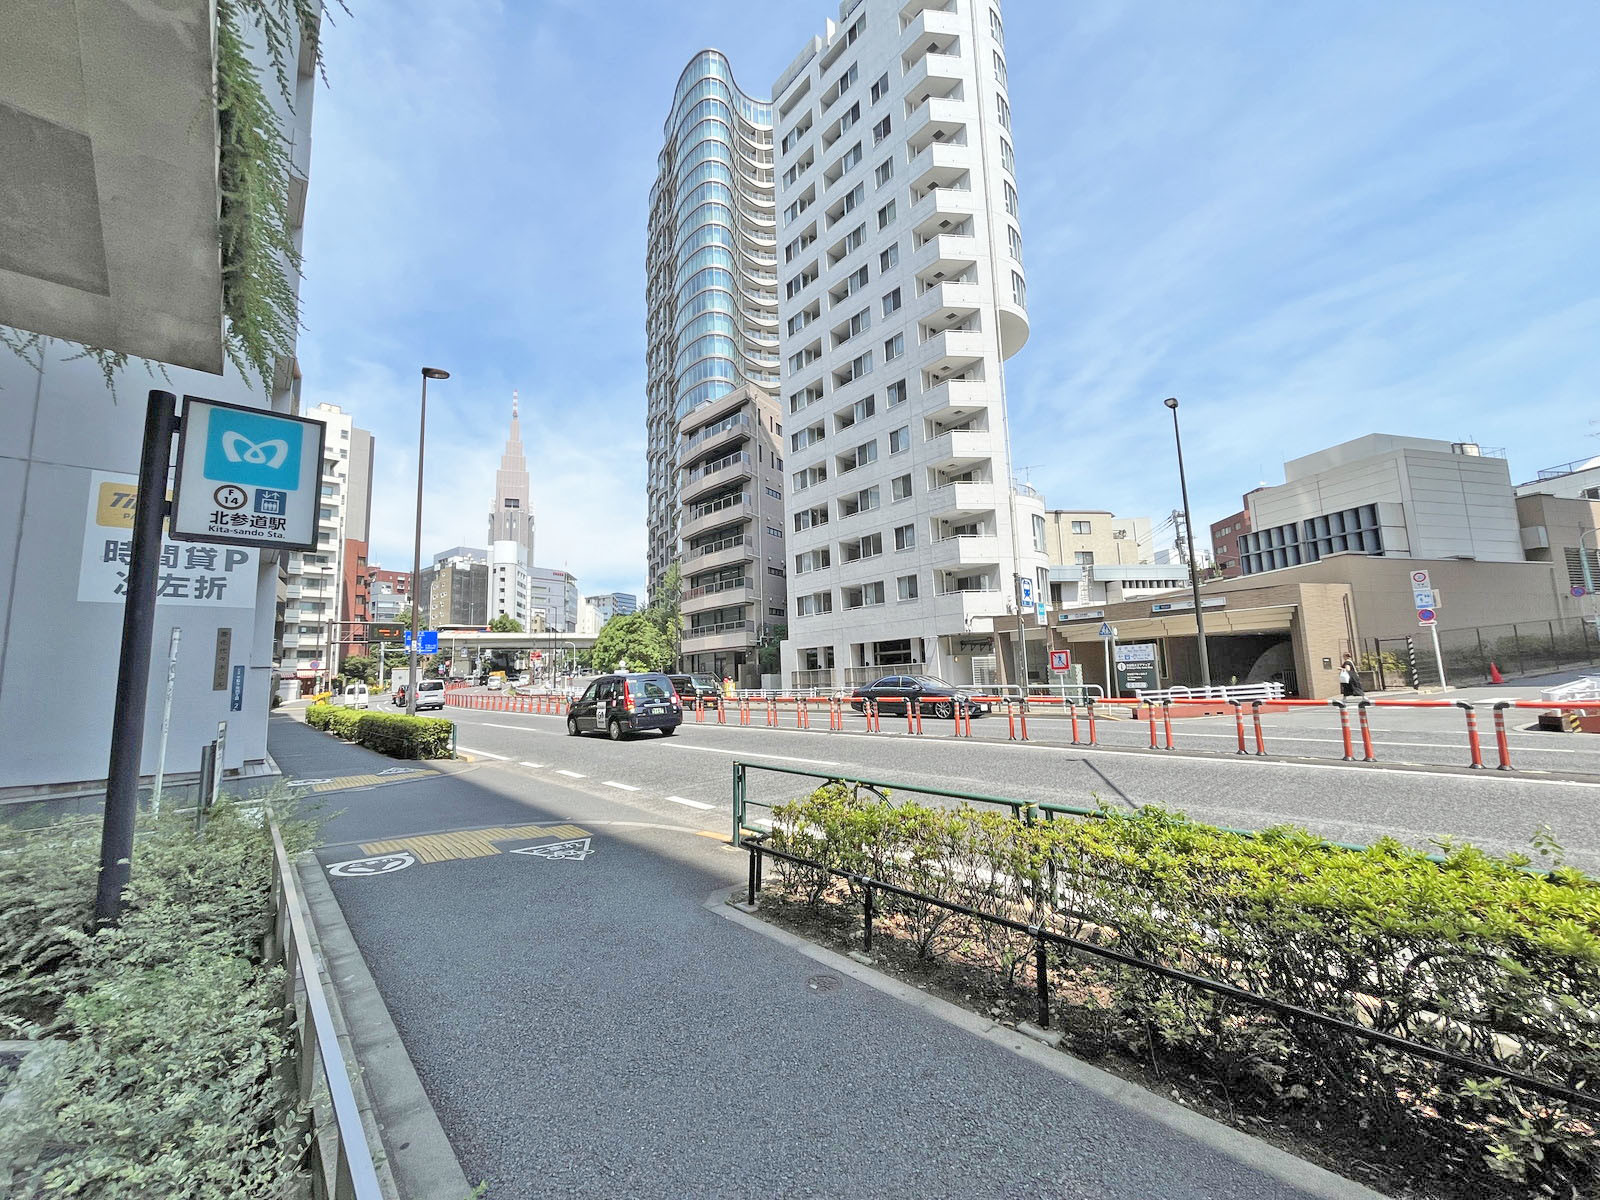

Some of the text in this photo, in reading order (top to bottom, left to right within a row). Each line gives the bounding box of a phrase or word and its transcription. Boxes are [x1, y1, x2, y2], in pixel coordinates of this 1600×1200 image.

[224, 496, 239, 505] 14
[209, 510, 287, 531] 北参道駅
[208, 525, 286, 539] Kita-sando Sta.
